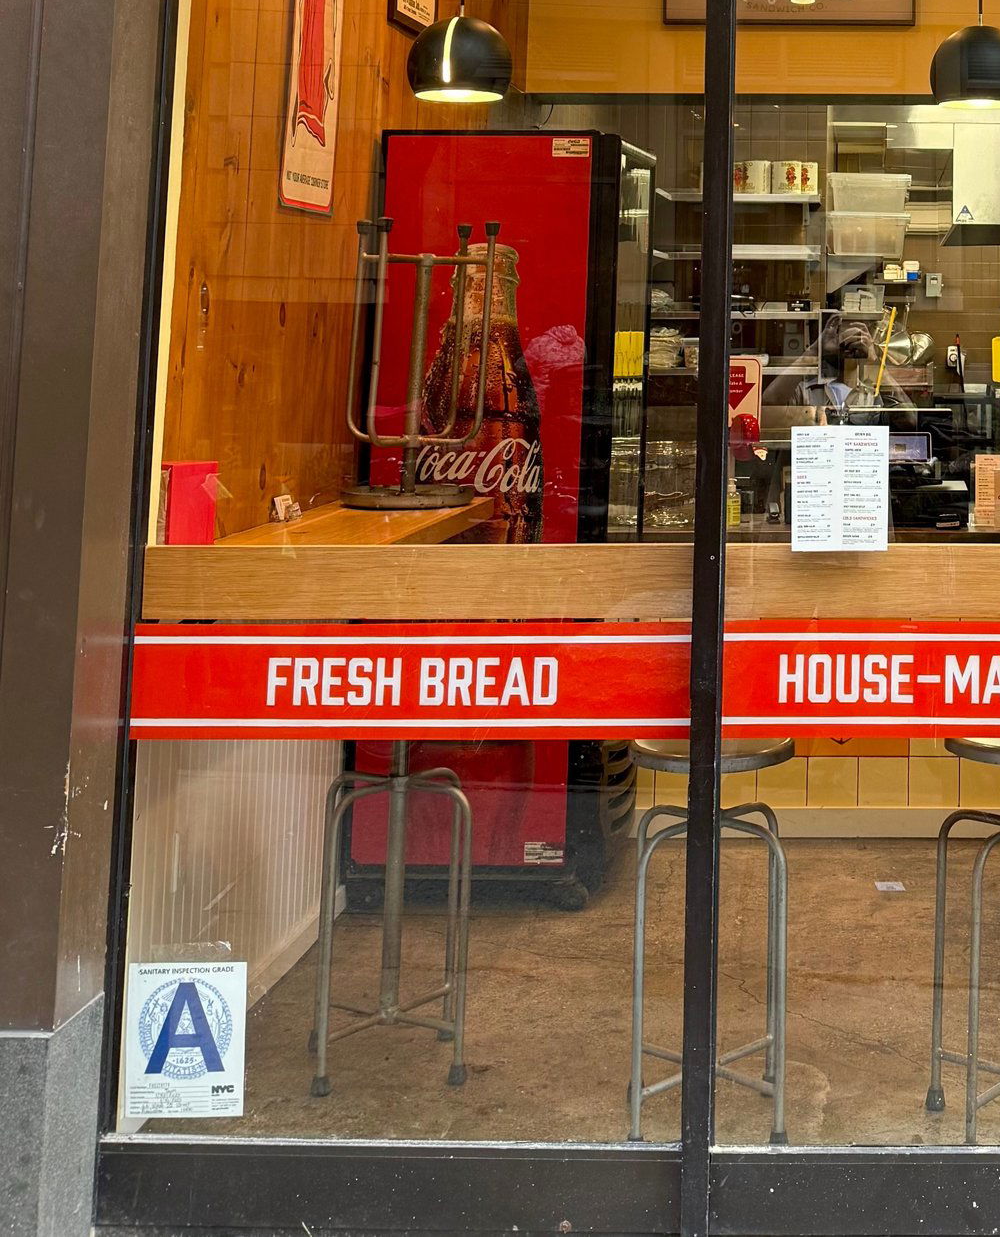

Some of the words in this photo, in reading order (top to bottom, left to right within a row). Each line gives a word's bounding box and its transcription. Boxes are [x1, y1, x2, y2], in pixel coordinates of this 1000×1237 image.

[746, 1, 805, 13] SANDWICH
[266, 656, 403, 707] FRESH
[418, 656, 559, 707] BREAD
[144, 982, 225, 1074] A
[175, 1056, 194, 1064] 1625
[211, 1084, 235, 1094] NYC
